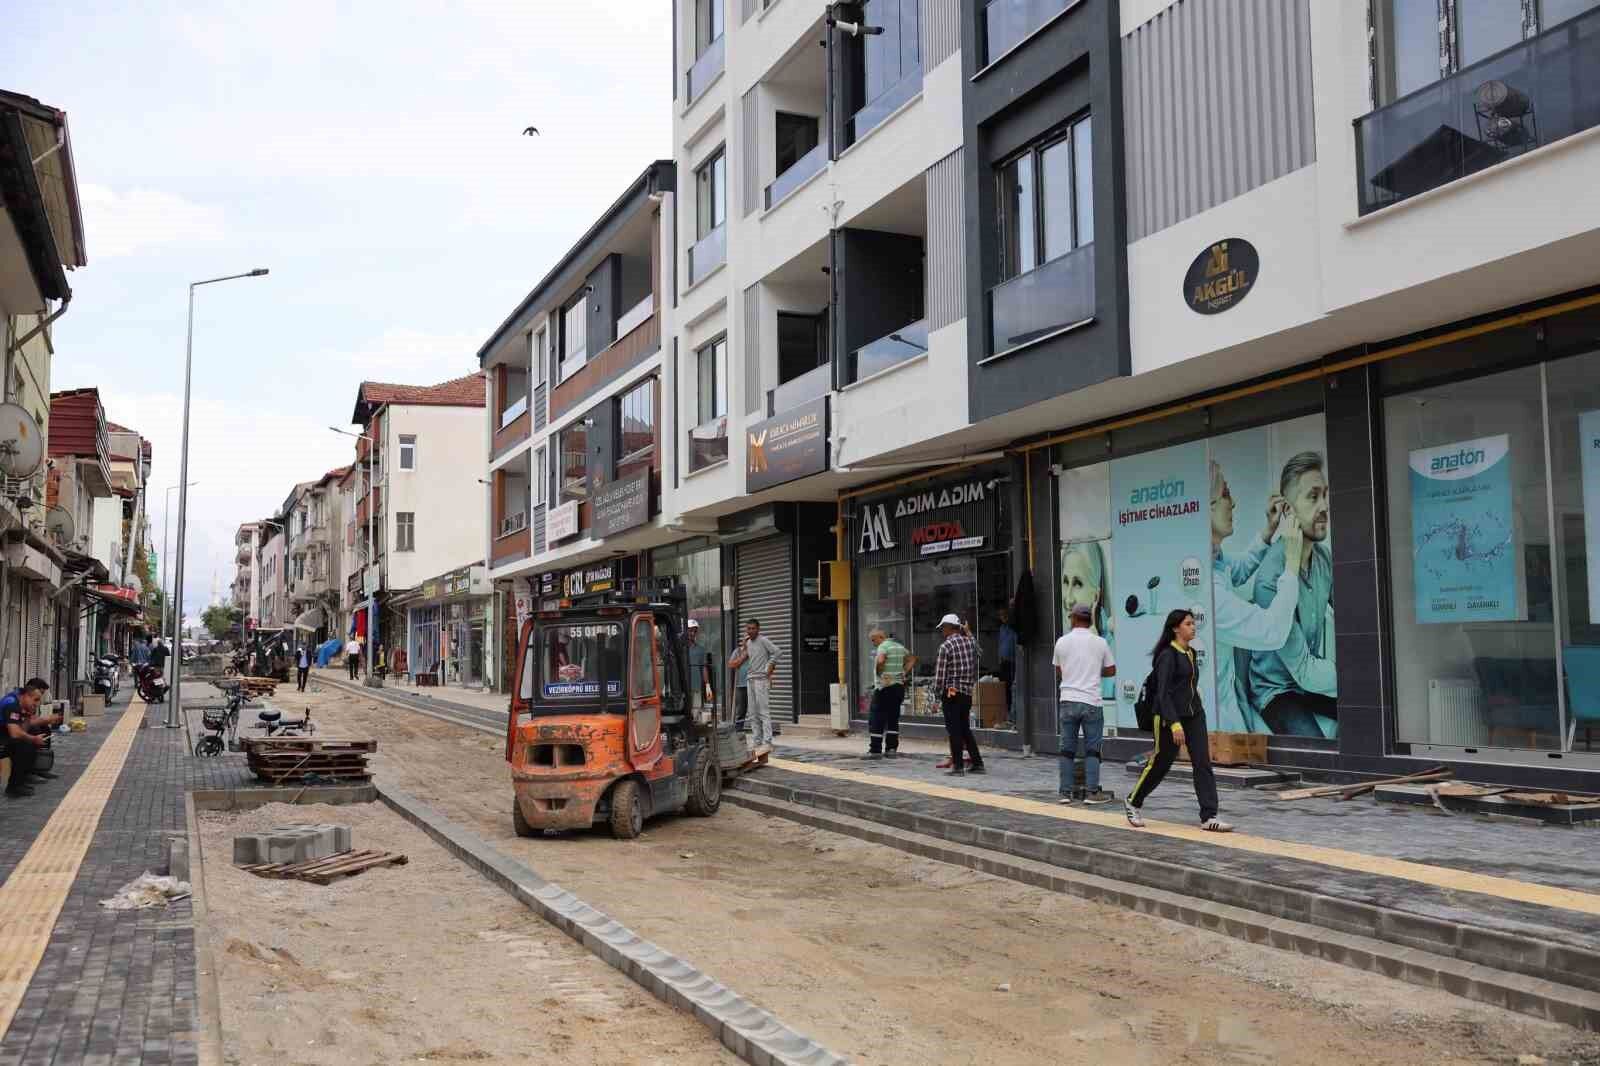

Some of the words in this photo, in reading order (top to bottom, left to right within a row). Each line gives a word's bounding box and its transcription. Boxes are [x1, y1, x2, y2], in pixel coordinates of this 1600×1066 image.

[1193, 269, 1249, 304] AKGÜL
[895, 492, 935, 518] ADIM
[938, 481, 985, 508] ADIM
[1119, 508, 1147, 527] İŞİTME
[1149, 500, 1200, 519] CİHAZLARI
[912, 522, 966, 545] MODA
[570, 626, 582, 638] 55
